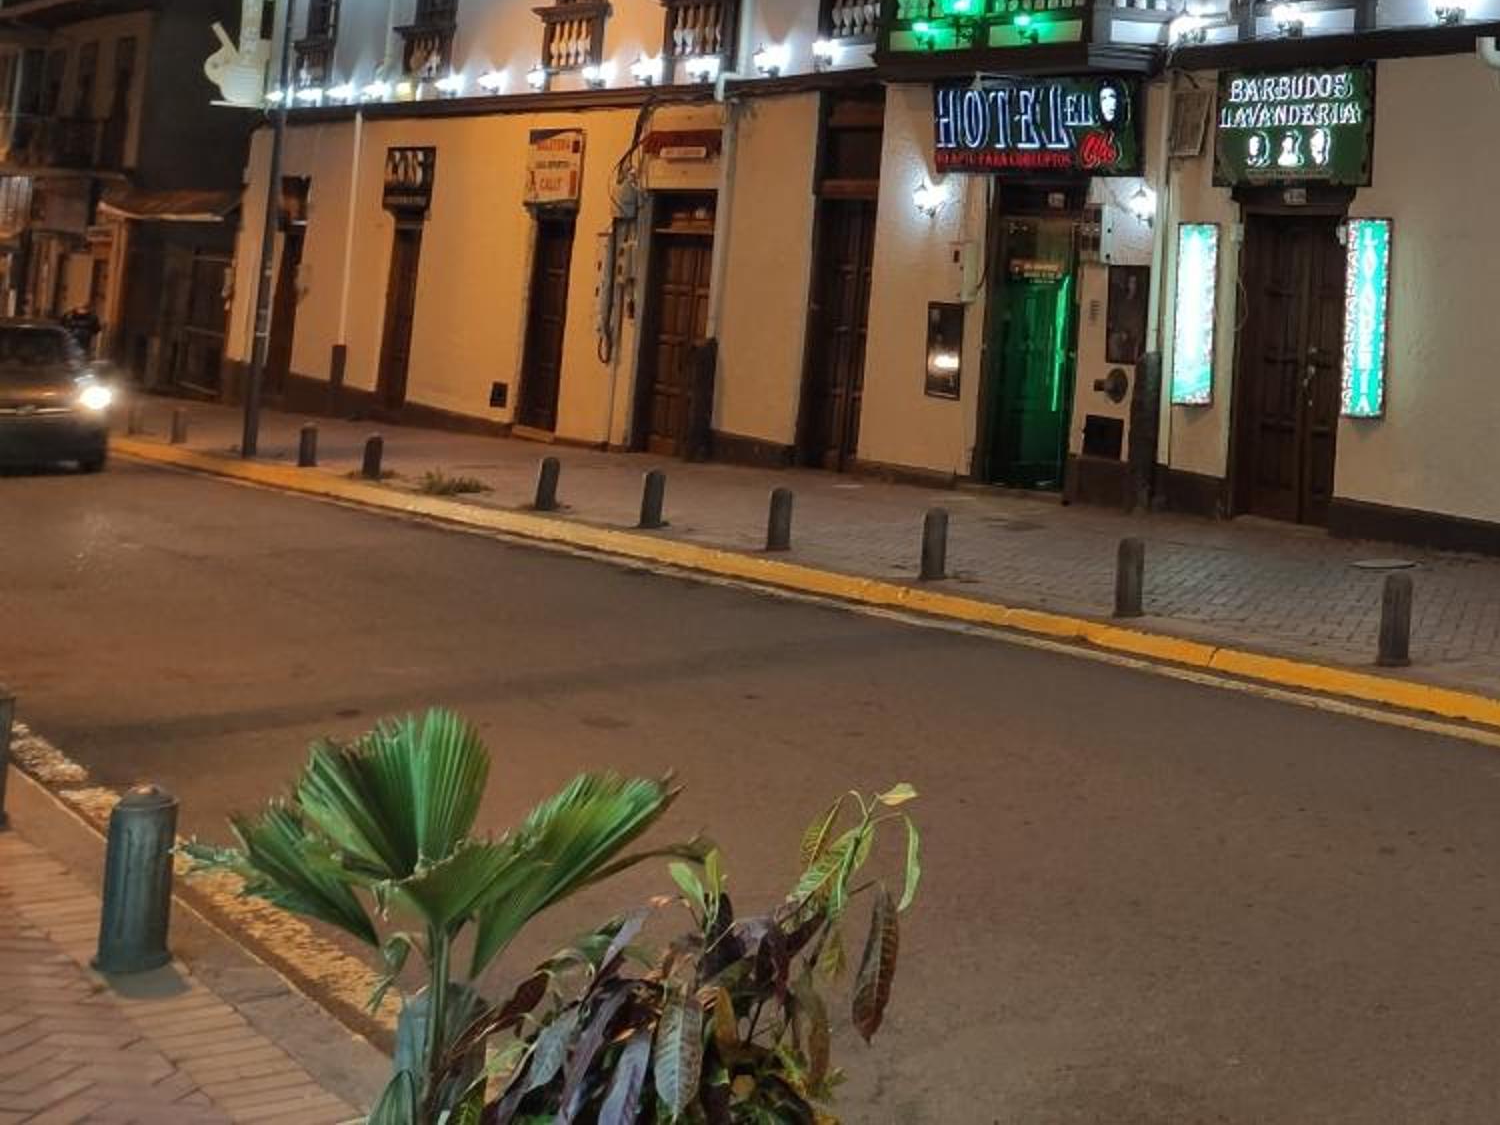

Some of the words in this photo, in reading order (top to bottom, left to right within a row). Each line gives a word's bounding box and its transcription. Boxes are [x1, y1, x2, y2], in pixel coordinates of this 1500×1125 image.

[1229, 74, 1351, 102] BARBUDOS
[936, 83, 1070, 149] HOTEL
[1219, 103, 1360, 128] LAVANDERIA
